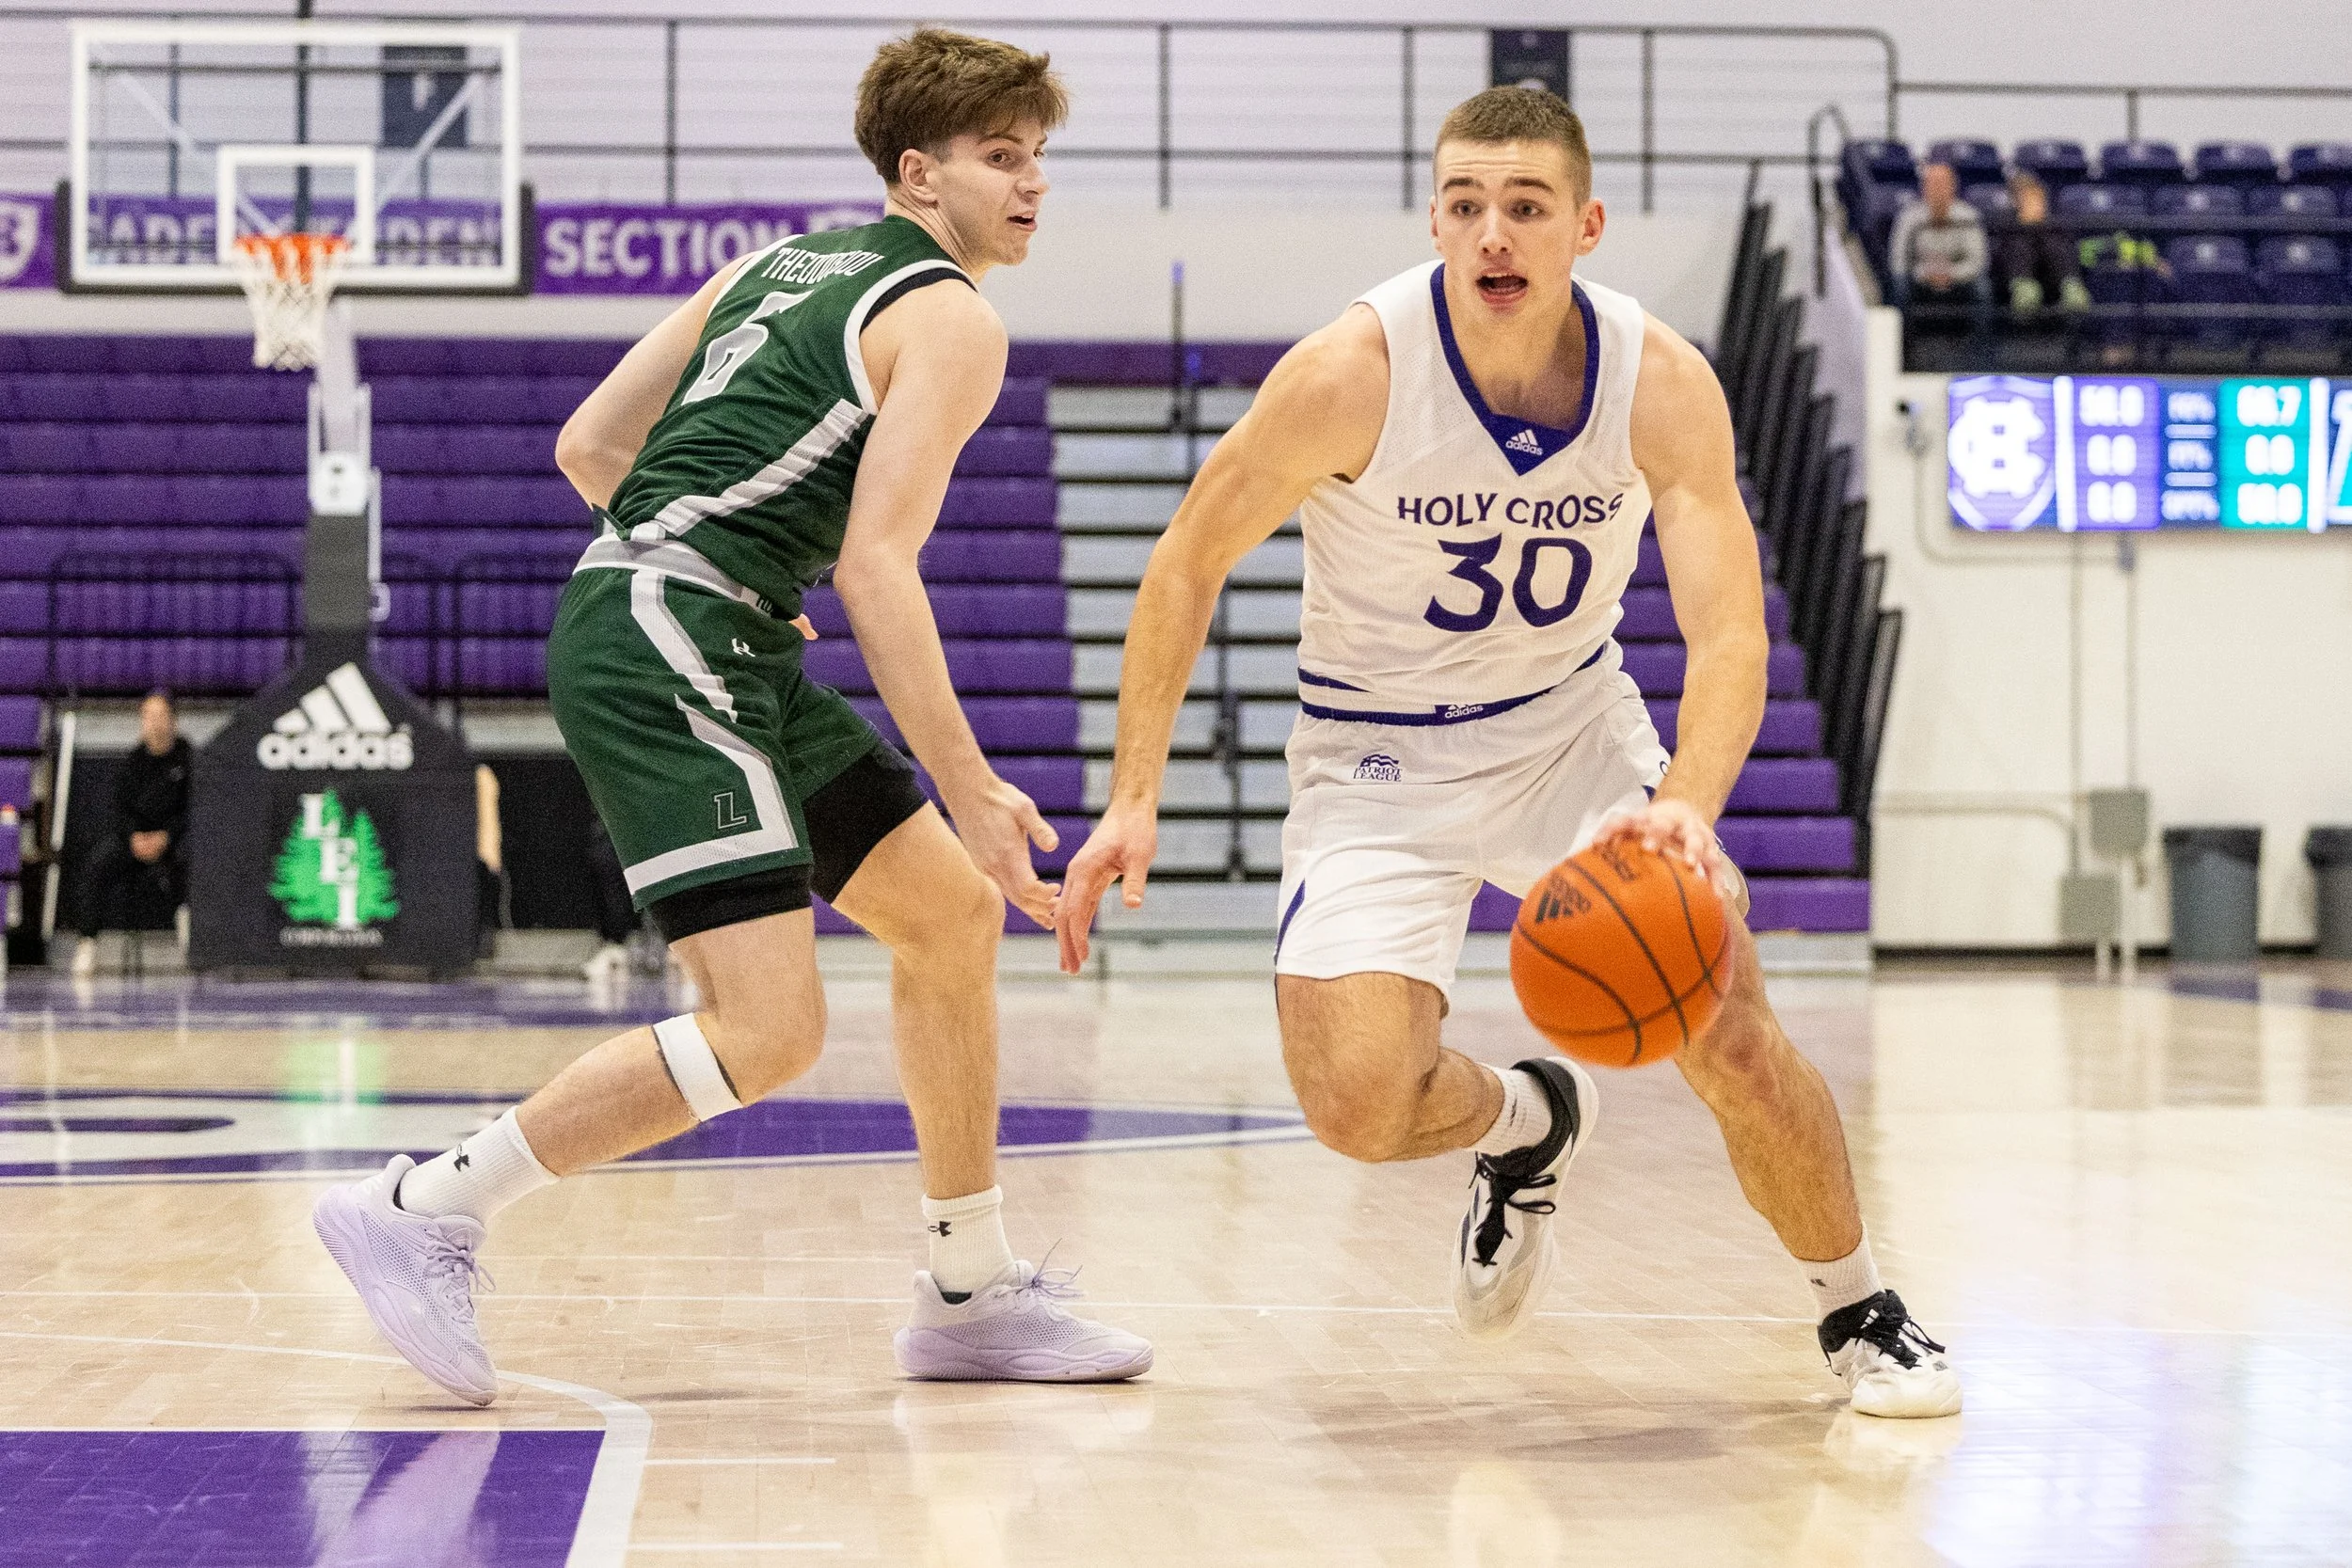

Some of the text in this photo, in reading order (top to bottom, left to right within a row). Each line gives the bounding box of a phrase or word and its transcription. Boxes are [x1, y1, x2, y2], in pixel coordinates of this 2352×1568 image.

[680, 291, 814, 405] 6
[1505, 440, 1543, 455] adidas
[1397, 493, 1624, 530] HOLY CROSS
[1423, 532, 1592, 632] 30
[1444, 705, 1484, 719] adidas
[257, 732, 414, 770] adidas
[1353, 772, 1402, 782] LEAGUE
[1355, 767, 1403, 775] PATRIOT
[713, 791, 748, 830] L
